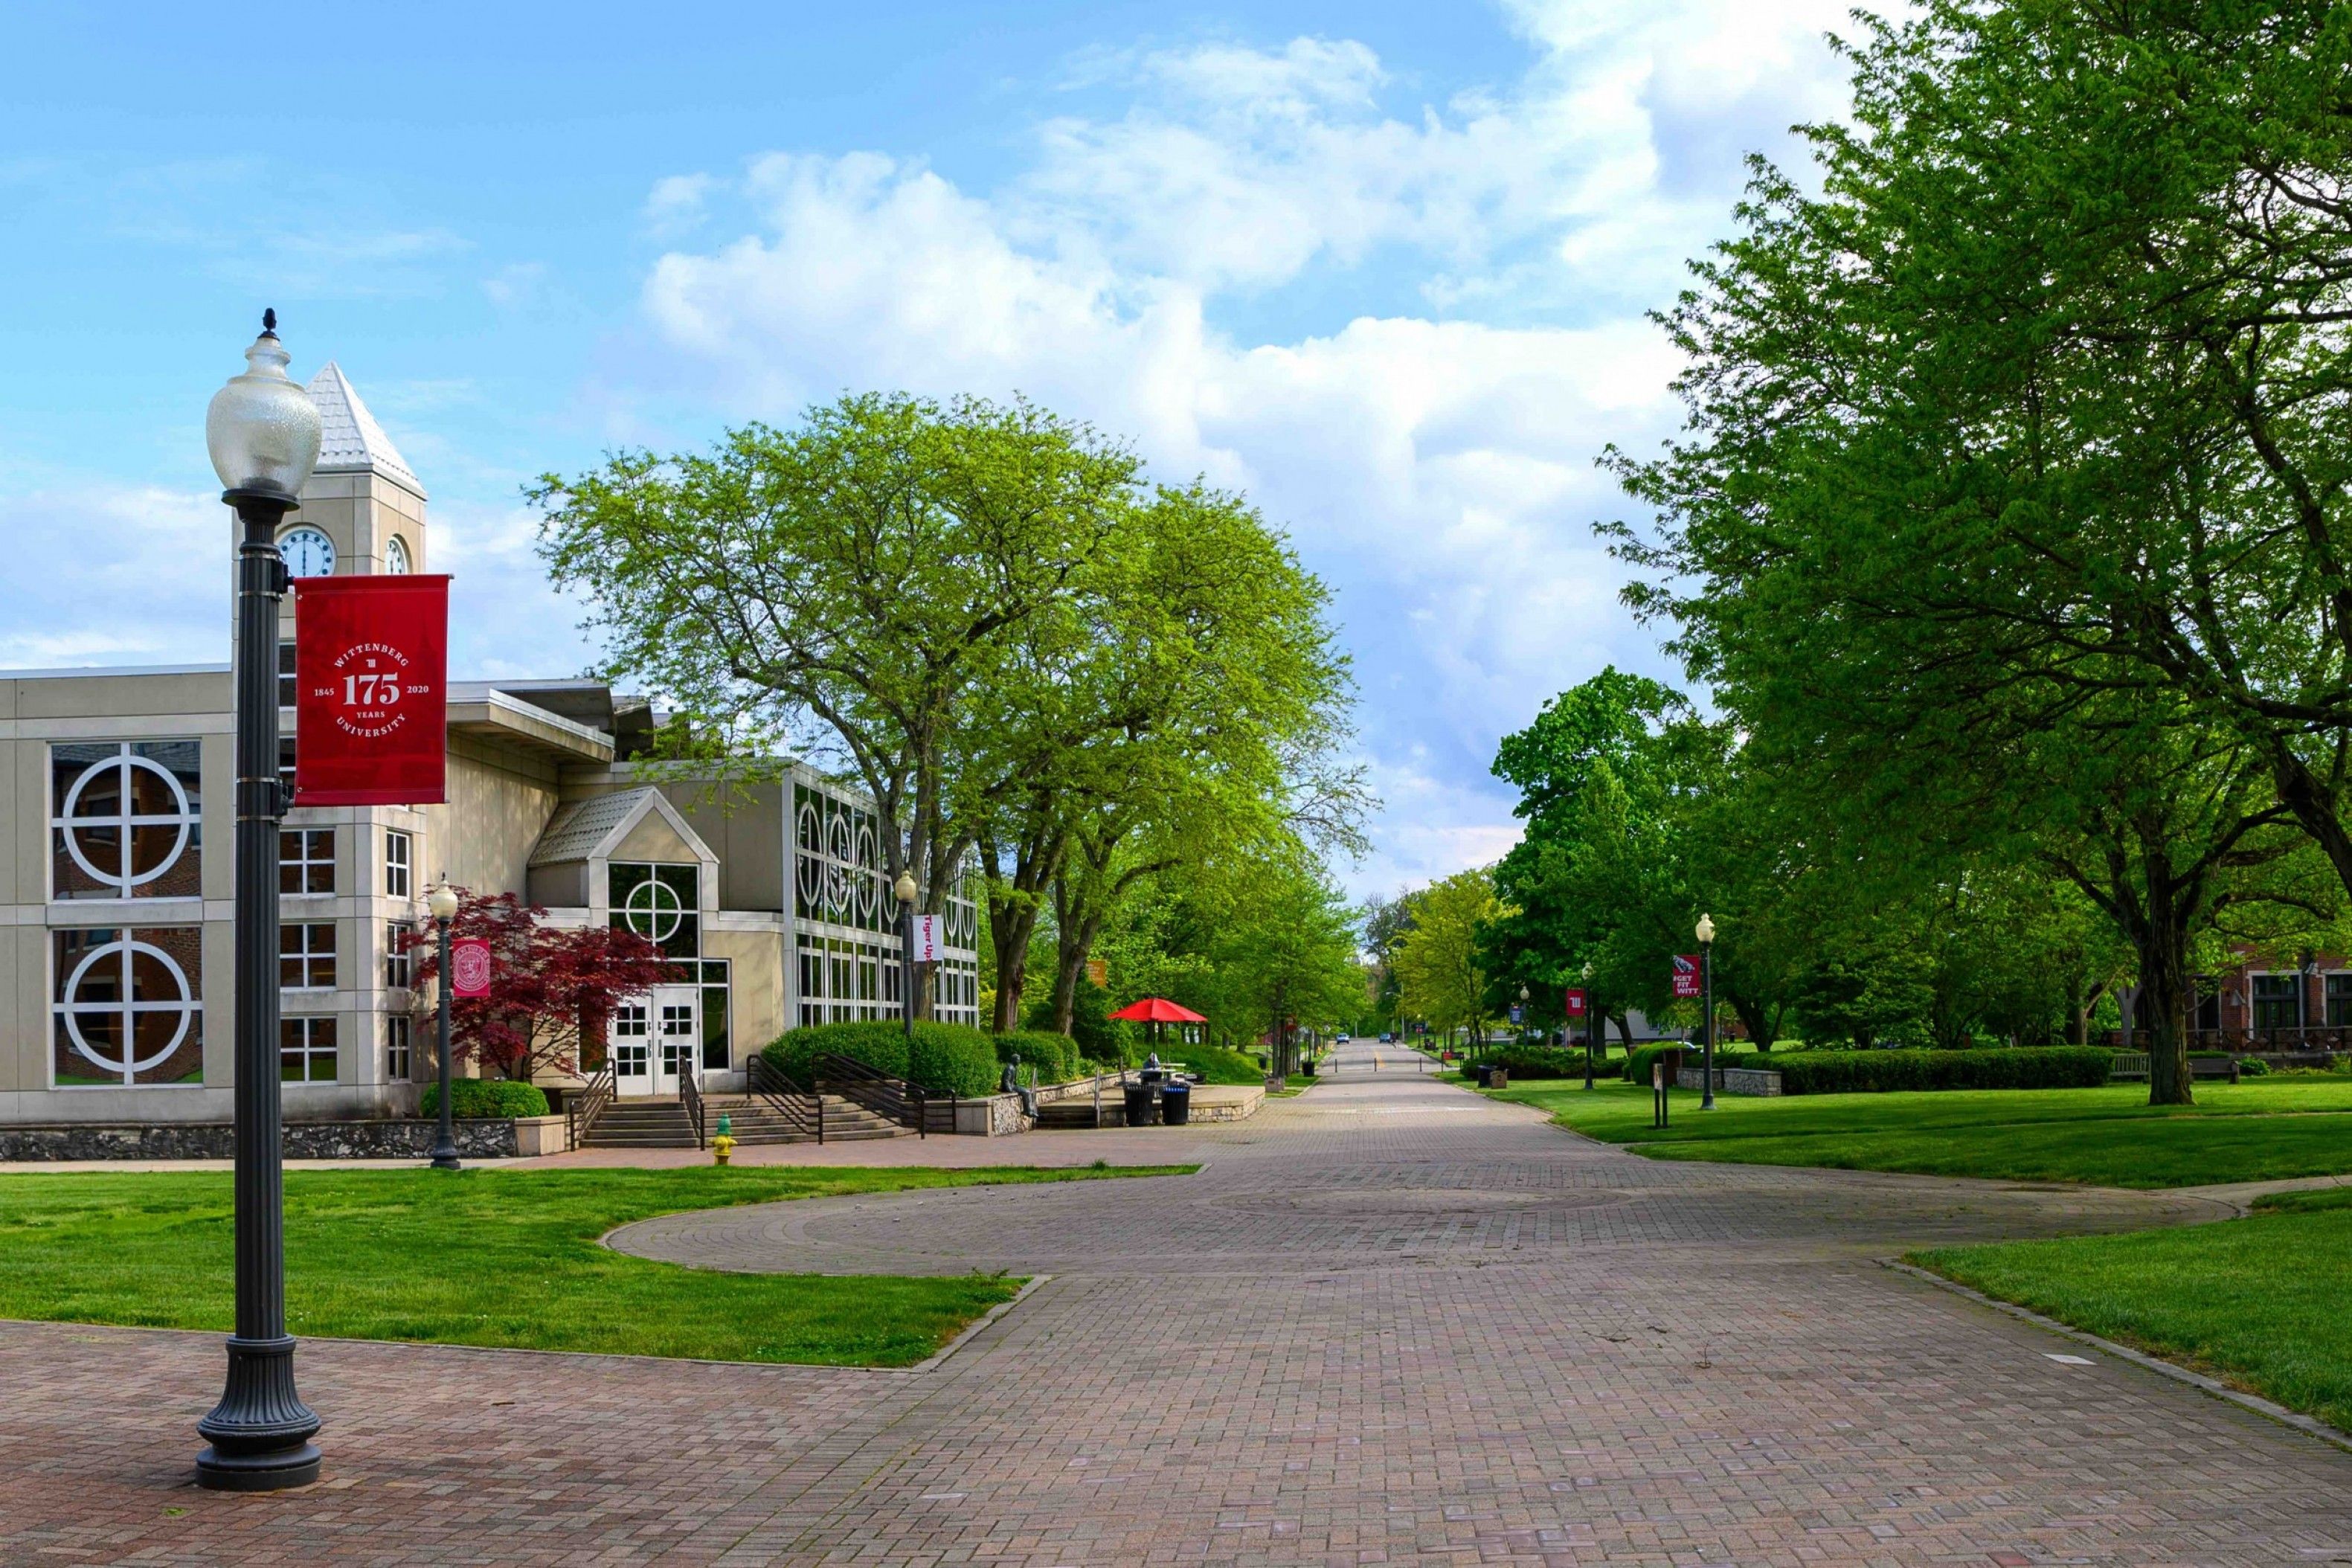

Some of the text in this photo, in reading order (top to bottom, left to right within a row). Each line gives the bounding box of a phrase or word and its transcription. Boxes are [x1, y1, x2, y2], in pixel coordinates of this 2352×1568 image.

[334, 643, 409, 668] WITTENBERG
[314, 672, 429, 705] 1845 175 2020
[336, 713, 405, 737] UNIVERSITY
[923, 915, 932, 942] Tiger
